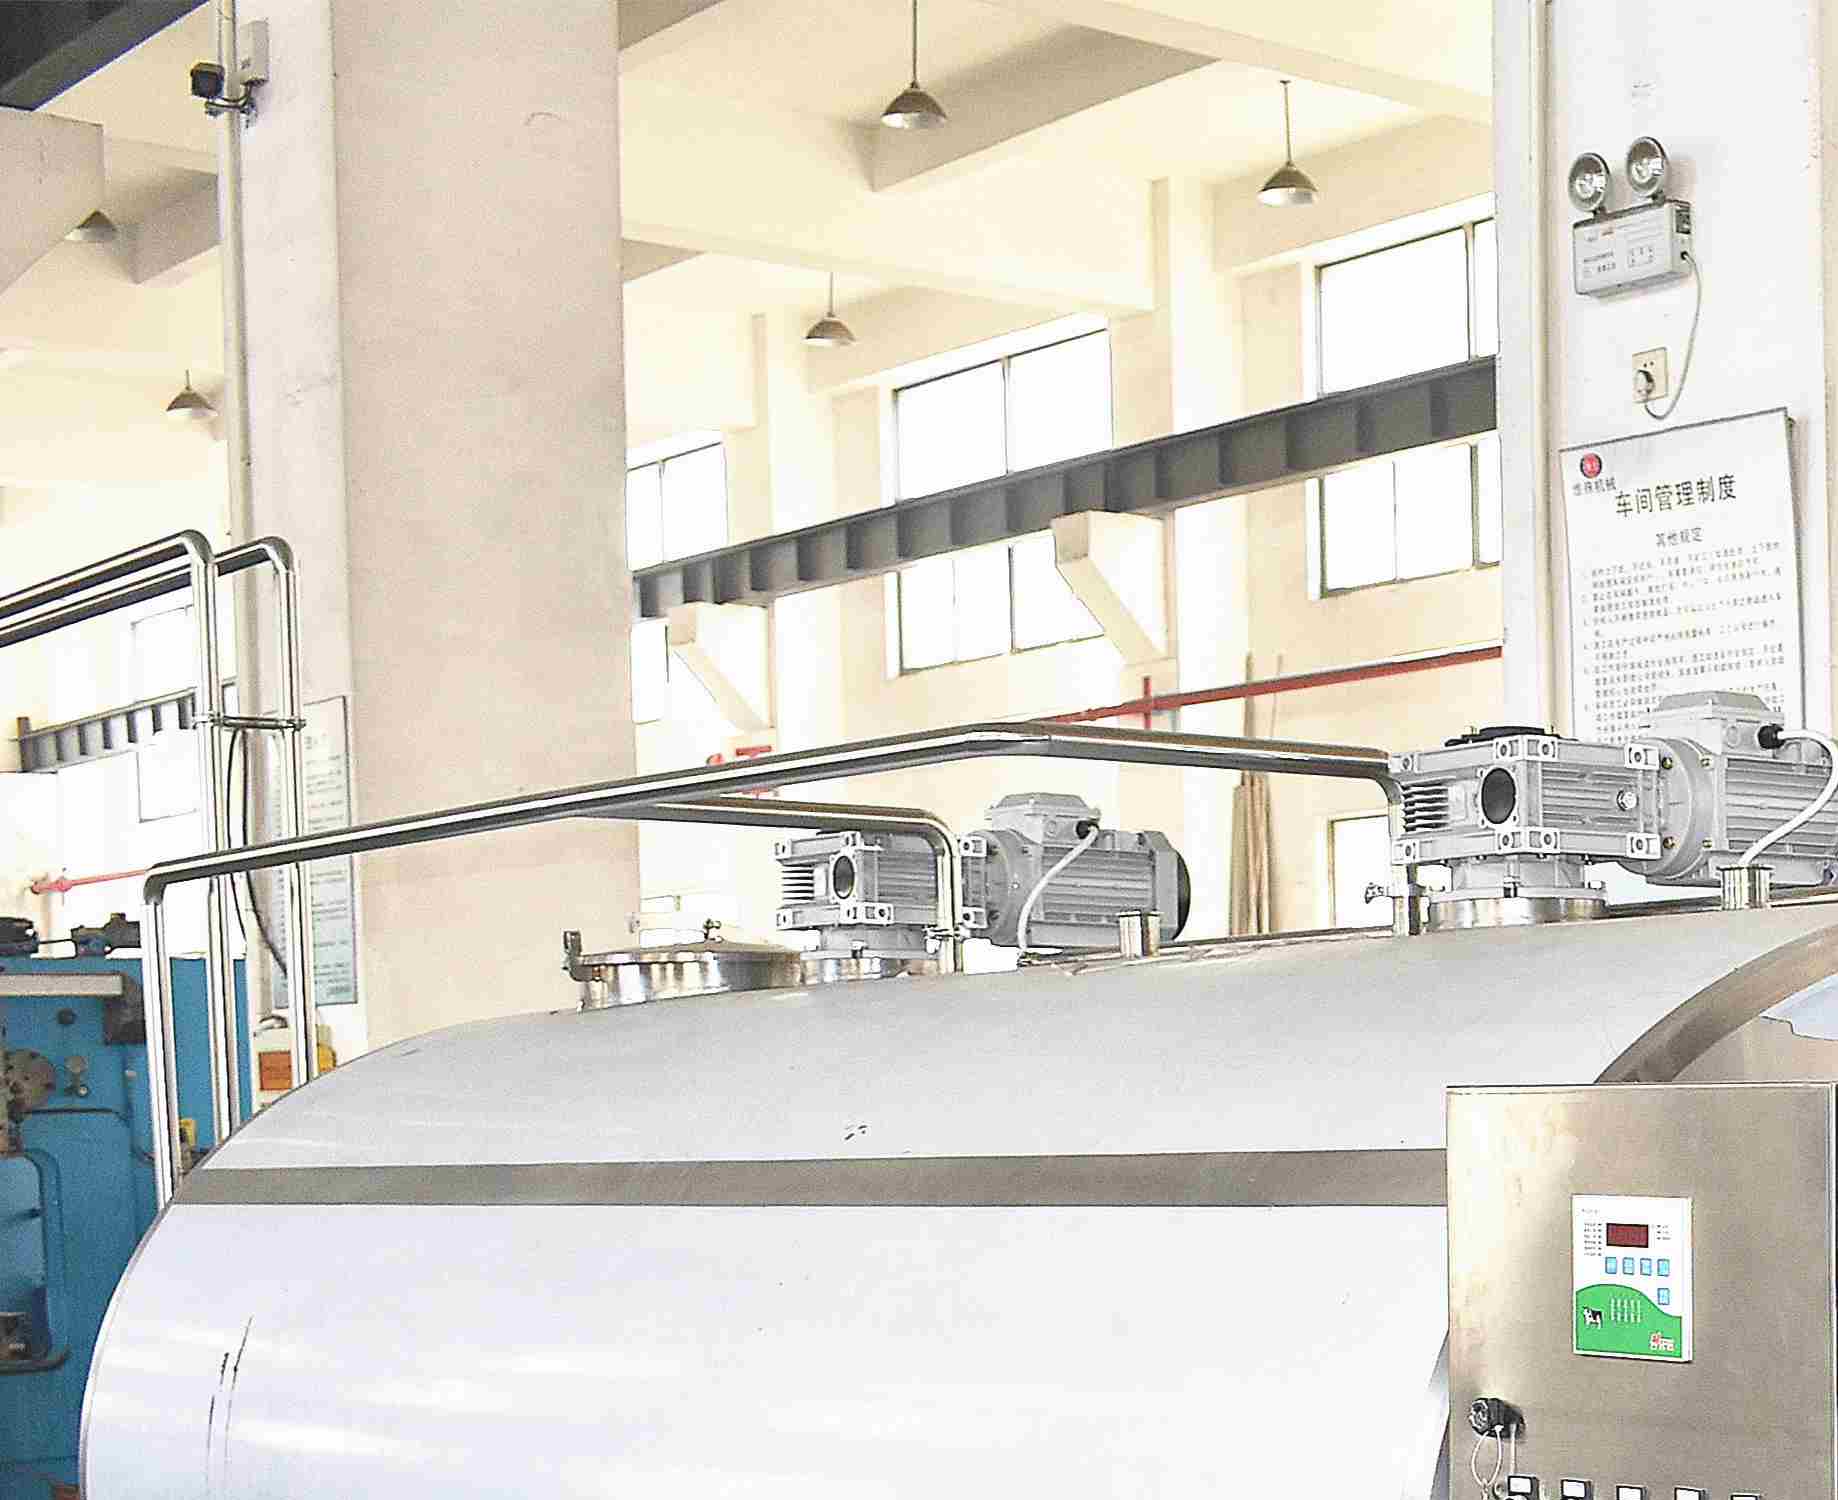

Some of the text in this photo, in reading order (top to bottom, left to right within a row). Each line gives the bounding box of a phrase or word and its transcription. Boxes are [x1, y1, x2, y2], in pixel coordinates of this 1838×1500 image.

[1615, 473, 1737, 518] 车间管理制度
